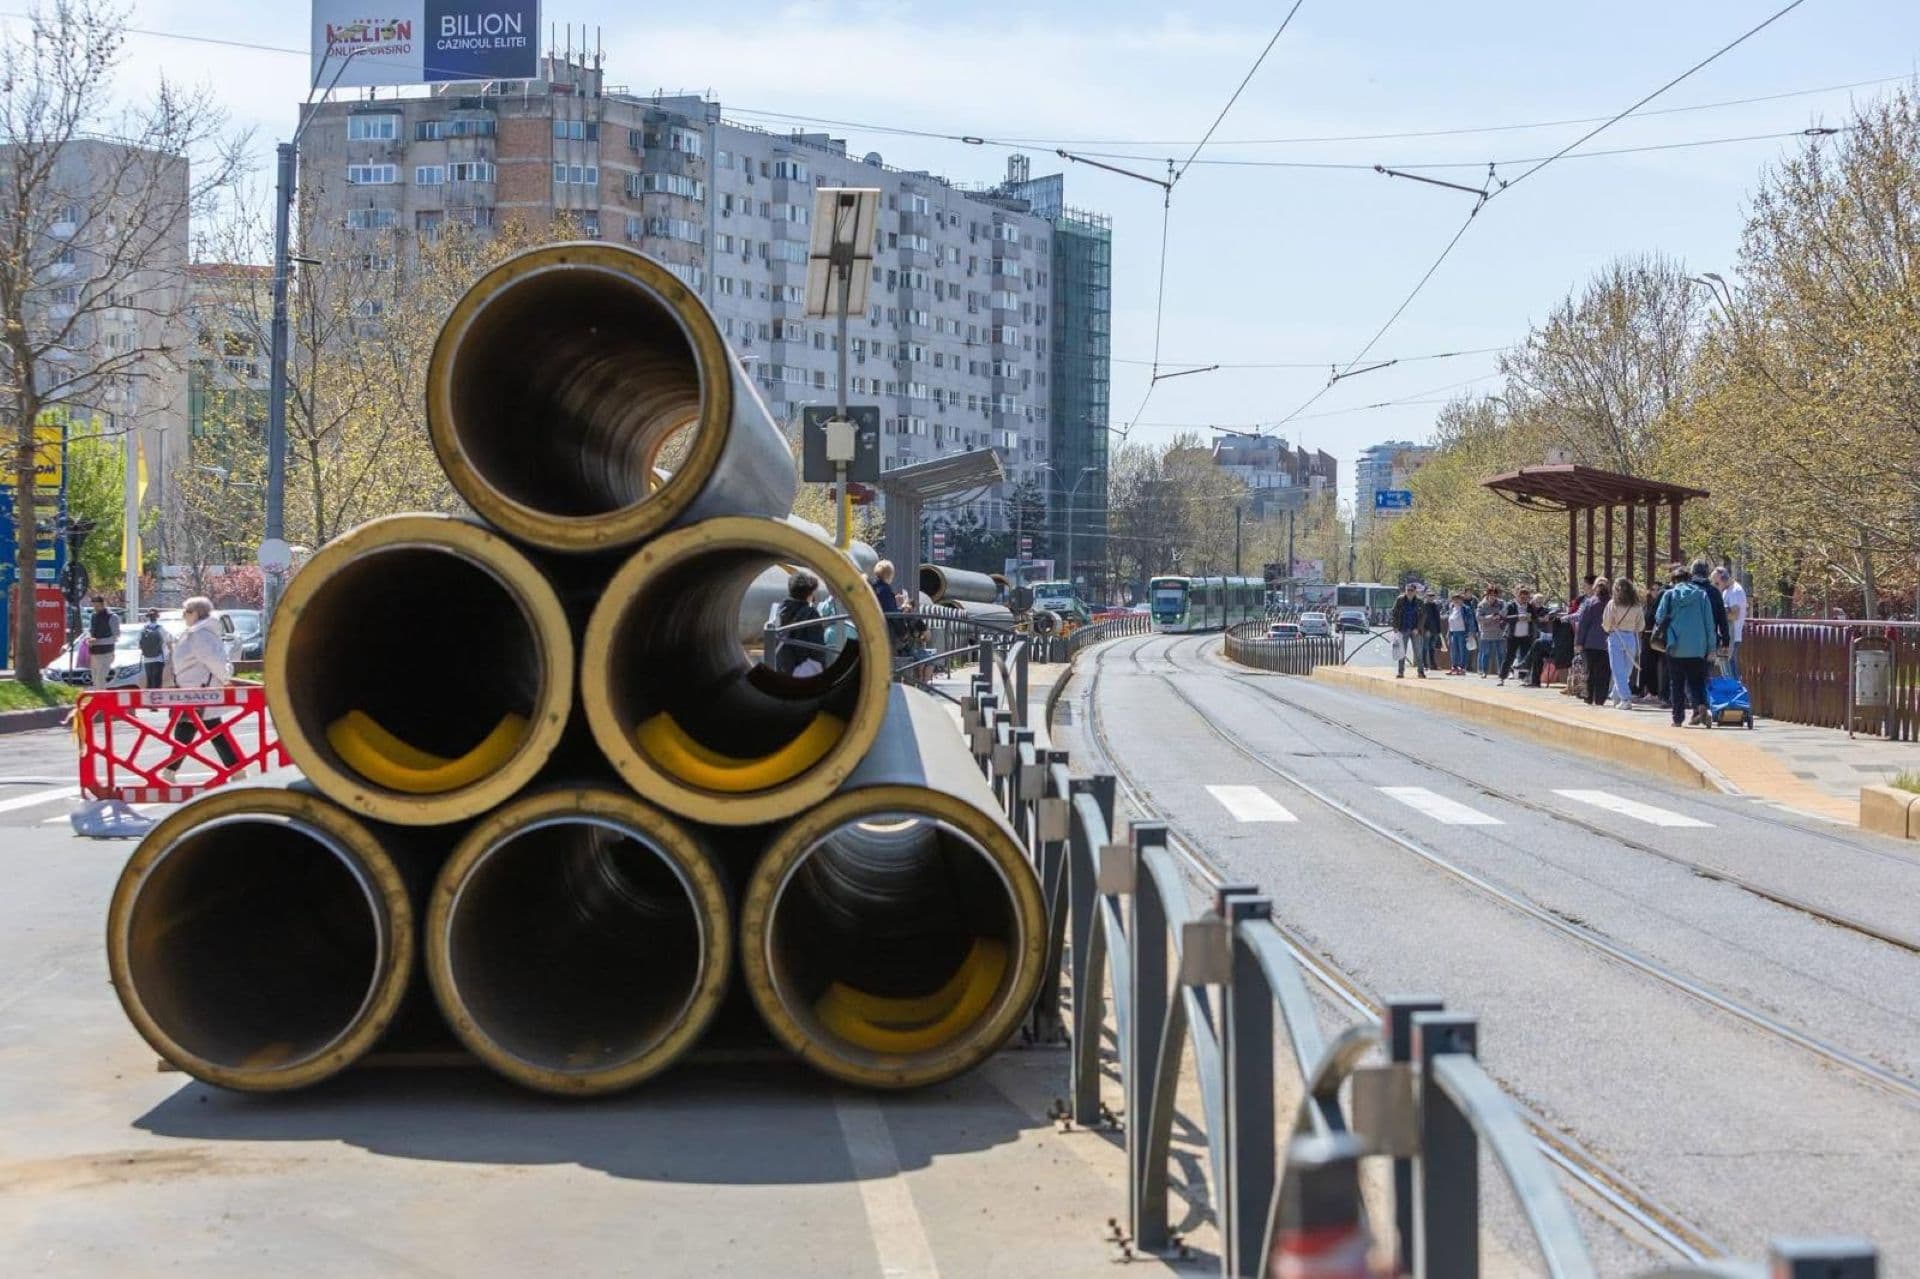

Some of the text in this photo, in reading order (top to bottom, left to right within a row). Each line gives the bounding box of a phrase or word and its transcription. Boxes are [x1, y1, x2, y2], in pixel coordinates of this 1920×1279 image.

[441, 12, 522, 37] BILION
[370, 43, 411, 55] CASINO
[437, 36, 527, 50] CAZINOUL ELITEI
[169, 692, 219, 701] ELSACO
